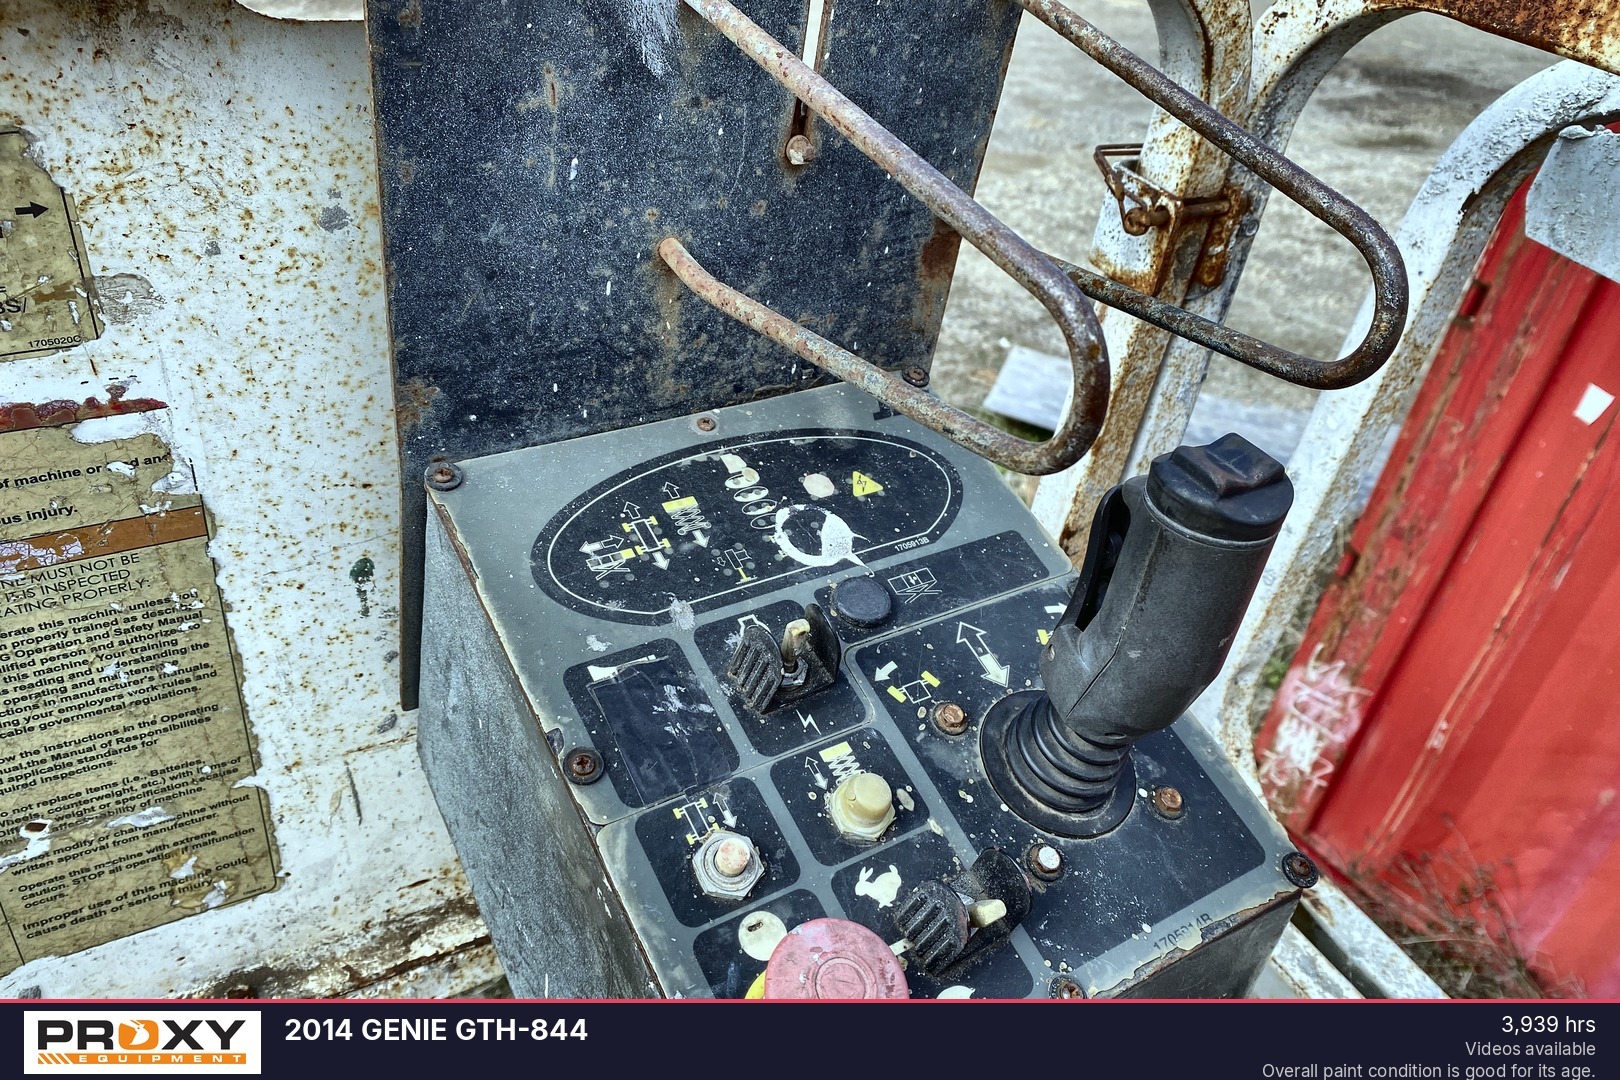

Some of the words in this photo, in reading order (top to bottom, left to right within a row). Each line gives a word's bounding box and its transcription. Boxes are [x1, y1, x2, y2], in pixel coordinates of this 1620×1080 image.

[28, 335, 81, 348] 1705020C
[14, 467, 82, 488] machine
[86, 465, 103, 475] or
[26, 504, 78, 523] injury.
[23, 588, 36, 600] IS
[40, 569, 131, 596] INSPECTED
[31, 565, 75, 584] MUST
[80, 557, 116, 574] NOT
[120, 552, 140, 566] BE
[0, 597, 57, 618] ATING
[0, 626, 35, 640] erate
[38, 619, 65, 631] this
[129, 597, 171, 612] unless
[11, 629, 69, 650] properly
[72, 617, 119, 635] trained
[122, 614, 138, 624] as
[15, 638, 84, 659] Operation
[86, 630, 111, 644] and
[113, 621, 155, 637] Safety
[158, 610, 204, 628] Manual
[0, 658, 36, 674] lified
[40, 648, 87, 667] person
[90, 640, 114, 653] and
[3, 672, 30, 684] this
[96, 649, 127, 662] Your
[130, 638, 179, 655] training
[13, 675, 65, 693] reading
[68, 667, 93, 680] and
[96, 645, 188, 675] uderstanding
[191, 641, 210, 653] the
[3, 686, 68, 706] operating
[71, 677, 96, 690] and
[23, 709, 54, 725] your
[57, 693, 125, 715] employers
[127, 684, 158, 698] work
[161, 676, 192, 690] rules
[195, 669, 218, 682] and
[44, 698, 57, 707] in
[60, 675, 156, 704] manufacturer's
[159, 661, 214, 681] manuals,
[0, 725, 36, 739] cable
[39, 701, 127, 731] governmental
[130, 686, 202, 707] regulations.
[19, 748, 41, 760] the
[43, 729, 120, 753] Instructions
[123, 724, 135, 734] in
[138, 718, 158, 729] the
[160, 703, 219, 724] Operating
[7, 761, 74, 784] applicable
[76, 744, 138, 766] standards
[141, 738, 160, 749] for
[51, 744, 97, 762] Manual
[100, 739, 113, 750] of
[115, 715, 212, 746] Responsibilities
[12, 802, 34, 815] not
[36, 791, 83, 809] replace
[85, 780, 120, 795] items
[150, 758, 206, 778] Batteries,
[47, 786, 138, 815] counterweight,
[140, 776, 166, 794] etc.)
[169, 769, 194, 786] with
[229, 756, 242, 767] of
[54, 804, 97, 823] weight
[98, 800, 112, 811] or
[114, 782, 189, 806] specification
[191, 771, 239, 789] because
[139, 798, 152, 810] of
[155, 786, 206, 805] machine.
[11, 859, 54, 876] written
[57, 842, 110, 865] approval
[112, 833, 140, 848] from
[142, 811, 221, 839] manufacturer.
[53, 837, 95, 856] modify
[98, 833, 111, 843] or
[210, 794, 250, 811] without
[18, 873, 66, 893] Operate
[68, 865, 91, 878] this
[146, 841, 171, 856] with
[172, 830, 217, 849] extreme
[21, 882, 70, 902] caution.
[72, 868, 106, 886] STOP
[109, 864, 123, 876] all
[192, 826, 256, 852] malfunction
[22, 905, 84, 932] Improper
[88, 897, 112, 911] use
[115, 891, 129, 903] of
[131, 884, 157, 898] this
[159, 867, 213, 890] machine
[215, 855, 249, 873] could
[24, 891, 70, 910] occurs.
[26, 922, 68, 940] cause
[69, 908, 108, 927] death
[110, 901, 125, 914] or
[126, 889, 176, 909] serious
